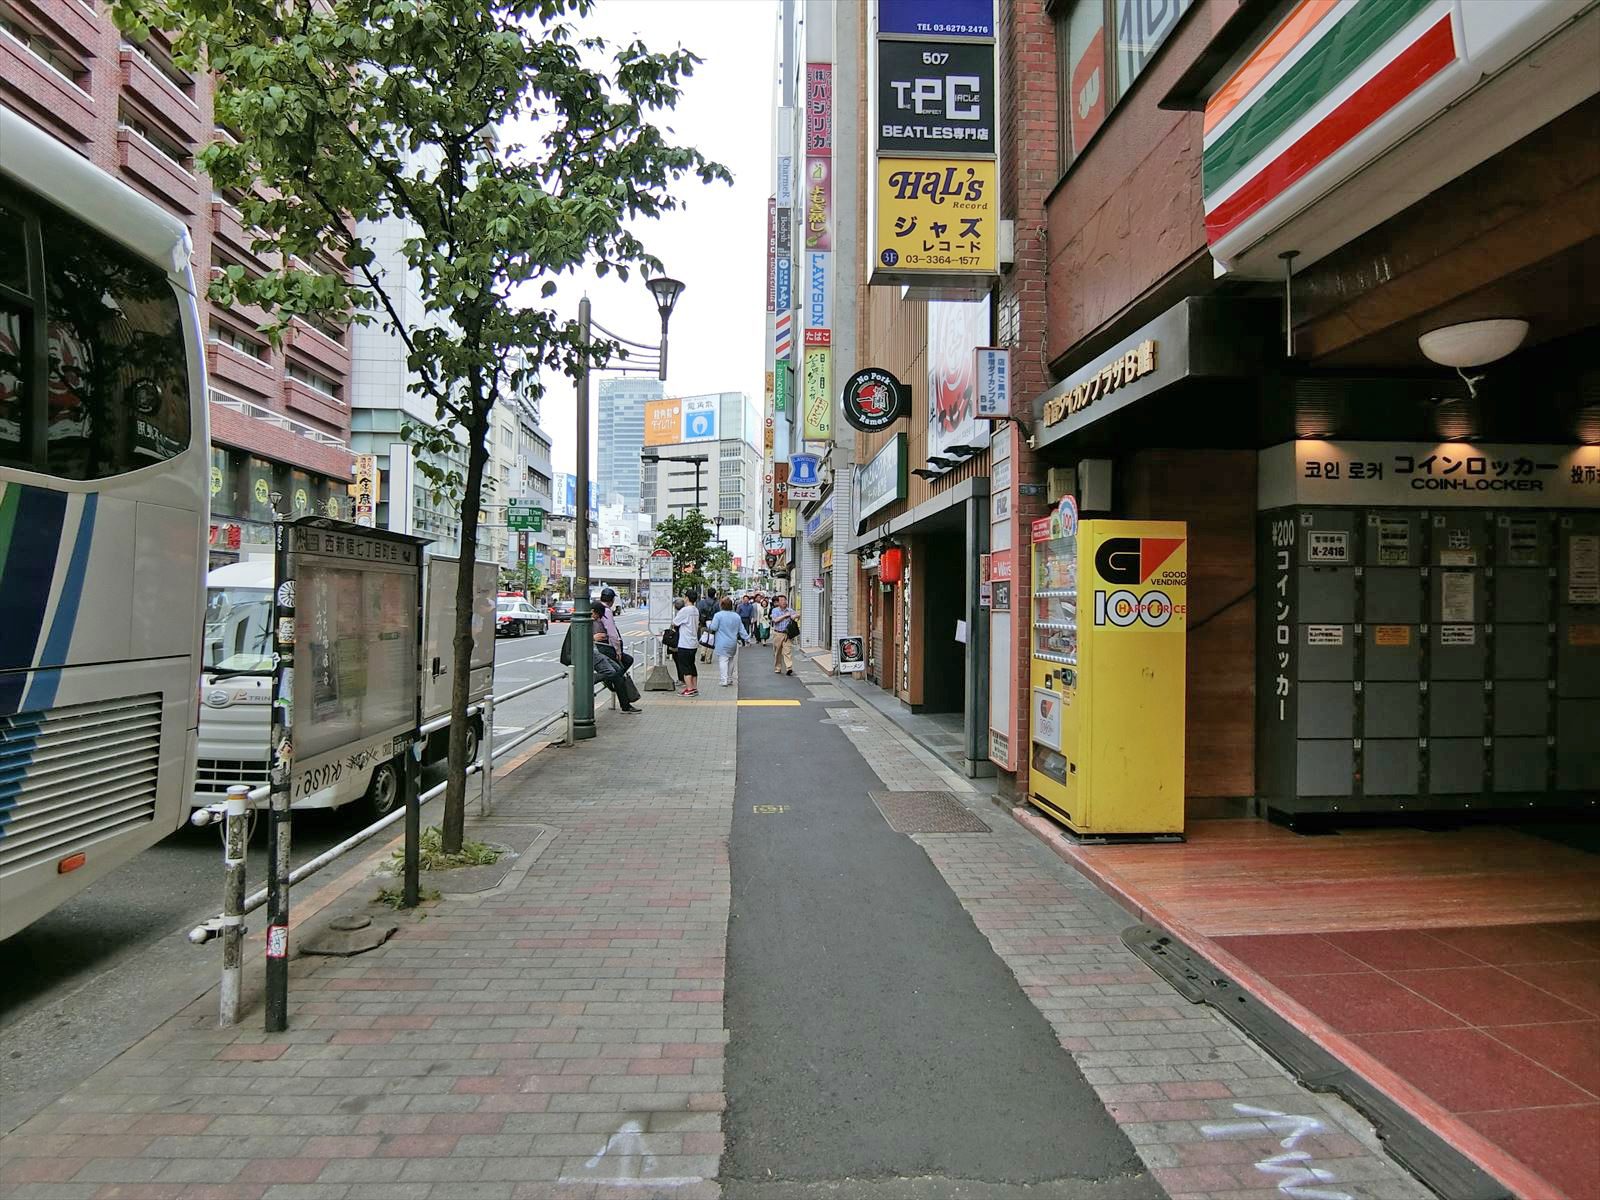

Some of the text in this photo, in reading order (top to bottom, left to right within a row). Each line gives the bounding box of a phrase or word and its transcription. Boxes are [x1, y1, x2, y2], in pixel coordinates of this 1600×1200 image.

[917, 23, 988, 33] TEL 03-6279-2476
[922, 52, 950, 65] 507
[952, 201, 988, 210] Record
[894, 216, 982, 239] ジャズ
[923, 241, 981, 253] レコード
[905, 254, 980, 266] 03-3364-1577
[812, 253, 825, 327] LAWSON
[805, 331, 830, 342] たばこ
[856, 372, 891, 386] No Pork
[858, 414, 889, 425] Ramen
[1305, 461, 1383, 480] 코인 로커
[1394, 455, 1559, 476] コインロッカー
[1570, 465, 1600, 485] 投币
[1411, 477, 1544, 491] COIN-LOCKER
[793, 490, 816, 498] たばこ
[1272, 519, 1295, 547] ¥200
[1150, 578, 1187, 586] VENDING
[1094, 589, 1173, 628] 100
[1118, 604, 1187, 614] HAPPY PRICE
[1276, 551, 1289, 721] コインロッカー
